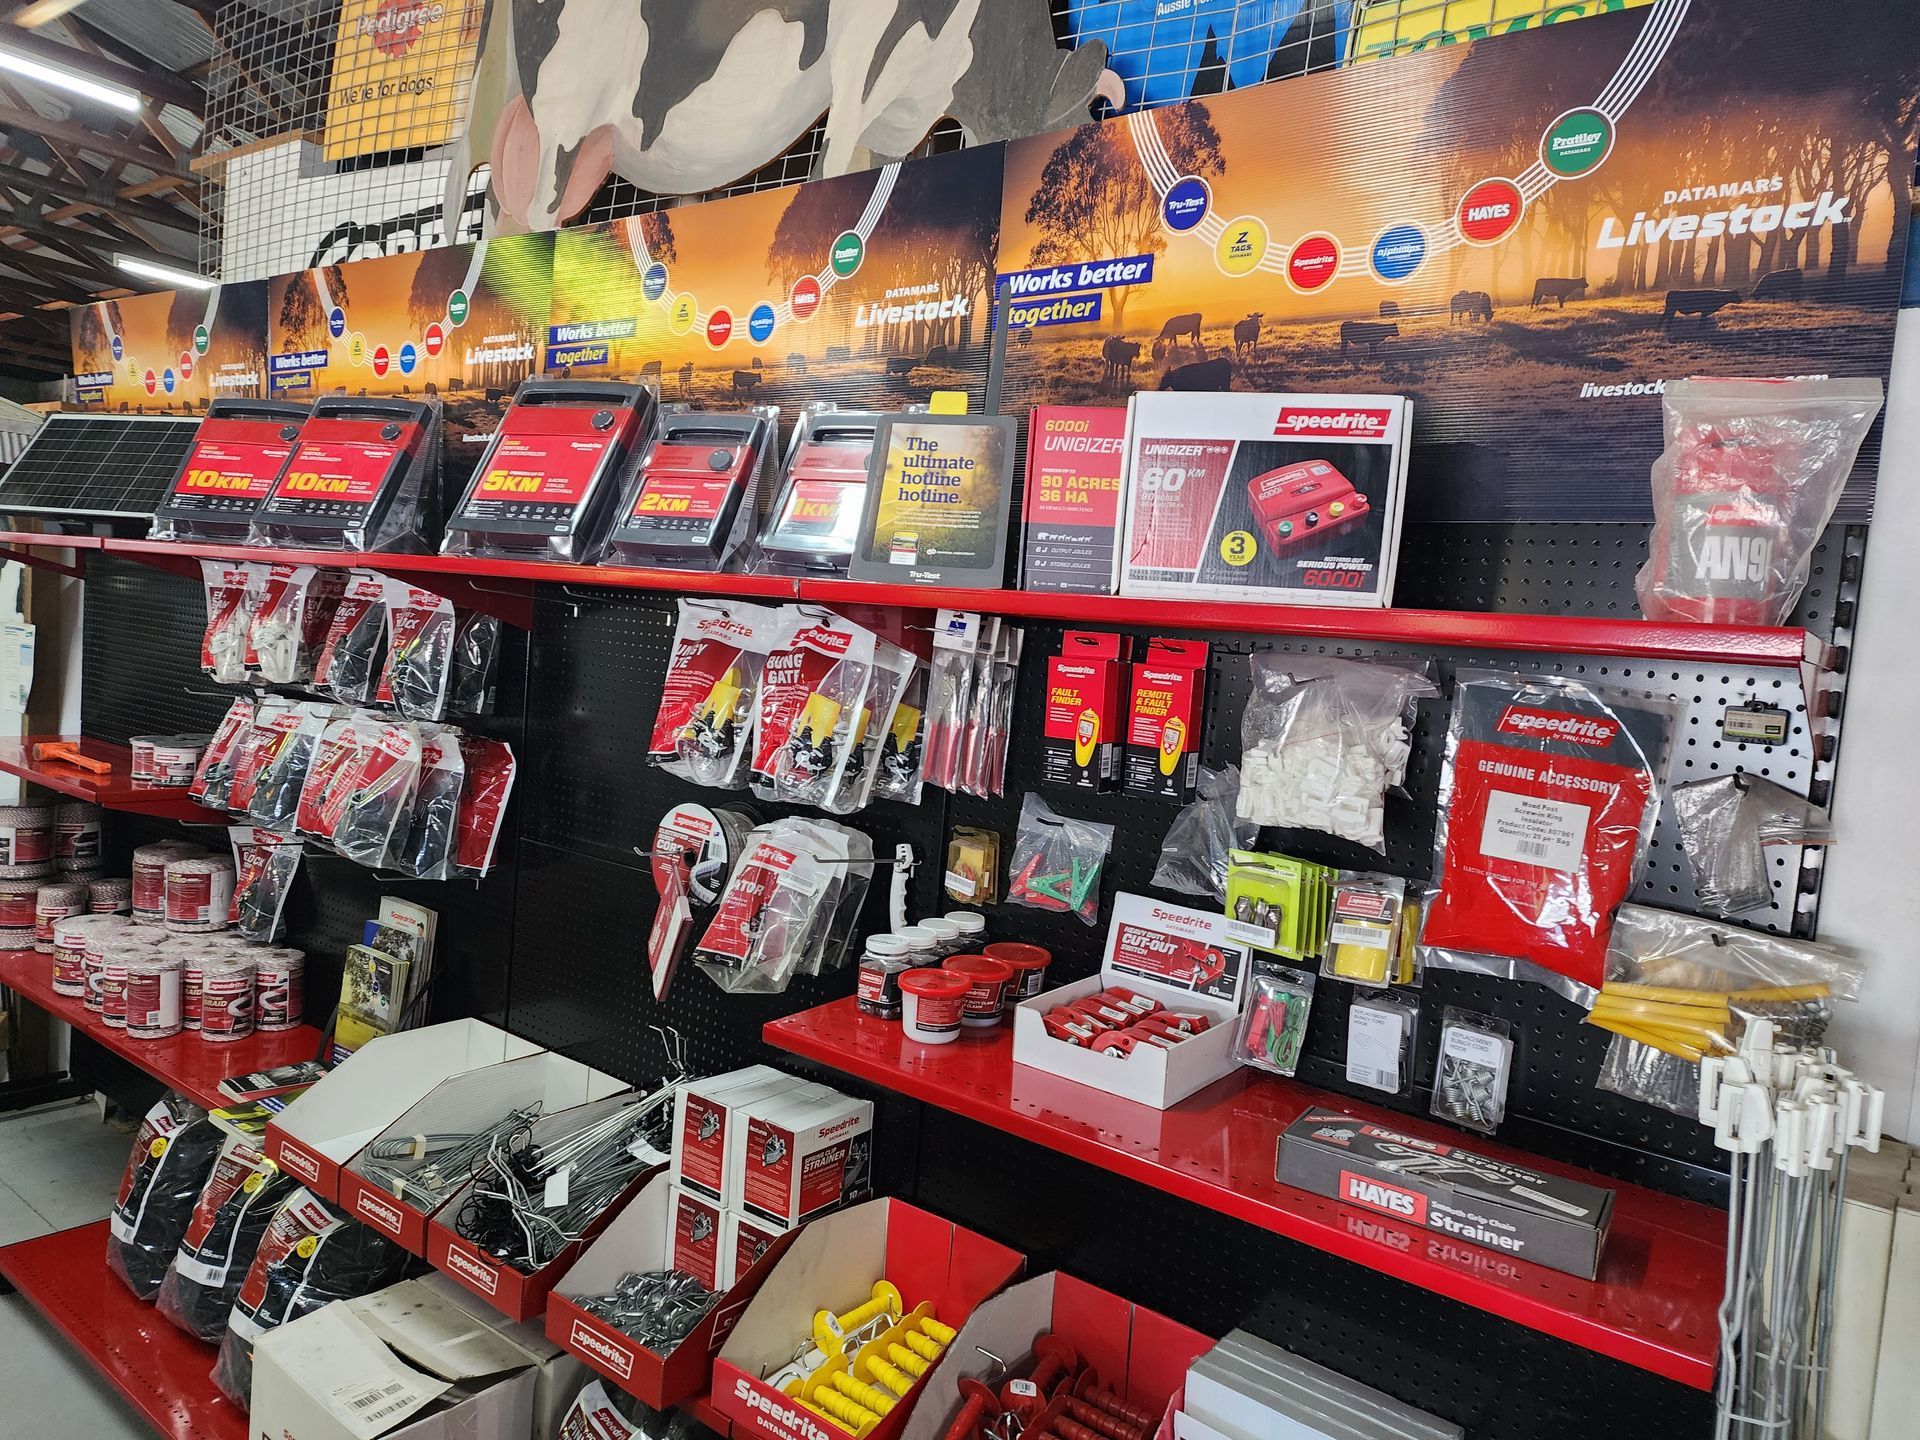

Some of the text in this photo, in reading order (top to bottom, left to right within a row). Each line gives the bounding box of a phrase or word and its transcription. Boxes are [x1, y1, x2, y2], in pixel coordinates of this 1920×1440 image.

[354, 4, 444, 39] Pedigree
[398, 76, 433, 95] dogs
[1552, 132, 1602, 150] Prattley
[1663, 177, 1784, 204] DATAMARS
[1168, 197, 1205, 210] Tru-Test
[1468, 203, 1511, 221] HAYES
[1596, 191, 1851, 249] Livestock
[1235, 231, 1249, 244] Z
[1230, 244, 1252, 252] TAGS
[1293, 255, 1335, 267] Speedrite
[1009, 261, 1146, 295] Works better
[885, 283, 940, 299] DATAMARS
[855, 295, 968, 328] Livestock
[1009, 299, 1095, 326] together
[556, 320, 634, 343] Works better
[275, 351, 327, 369] Works better
[464, 343, 534, 365] Livestock
[555, 347, 605, 367] together
[208, 371, 259, 388] Livestock
[276, 373, 309, 388] together
[1580, 379, 1666, 398] livestock
[1045, 419, 1089, 433] 6000i
[1286, 413, 1381, 431] speedrite
[906, 437, 938, 452] The
[1044, 436, 1124, 454] UNIGIZER
[1145, 444, 1203, 456] UNIGIZER
[903, 455, 975, 470] ultimate
[186, 469, 251, 490] 10KM
[285, 472, 350, 493] 10KM
[483, 470, 542, 493] 5KM
[900, 471, 961, 487] hotline
[1040, 475, 1120, 491] 90 ACRES
[1141, 467, 1206, 493] 60 KM
[639, 492, 690, 512] 2KM
[898, 488, 962, 504] hotline.
[1039, 489, 1089, 503] 36 HA
[1229, 536, 1245, 554] 3
[1296, 561, 1373, 571] SERIOUS POWER!
[1695, 535, 1772, 583] AN9
[909, 571, 941, 579] Tru-Test
[1303, 569, 1366, 588] 6000i
[1057, 664, 1095, 675] Speedrite
[1142, 670, 1183, 682] Speedrite
[1051, 687, 1079, 697] FAULT
[1051, 695, 1082, 706] FINDER
[1136, 688, 1173, 700] REMOTE
[1135, 706, 1168, 716] FINDER
[1136, 697, 1173, 709] & FAULT
[1509, 711, 1612, 739] speedrite
[1478, 760, 1620, 795] GENUINE ACCESSORY
[1514, 807, 1544, 817] Screw-in
[1521, 801, 1540, 810] Wood
[1497, 819, 1525, 830] Product
[1526, 824, 1546, 833] Code:
[1521, 816, 1552, 827] Insulator
[1498, 827, 1531, 840] Quantity:
[1532, 832, 1541, 840] 25
[1556, 837, 1571, 847] Bag
[1152, 907, 1212, 930] Speedrite
[1123, 926, 1166, 941] HEAVY DUTY
[1120, 944, 1149, 956] SWITCH
[1121, 933, 1178, 955] CUT-OUT
[1208, 985, 1219, 995] 10
[1354, 1009, 1387, 1020] REPLACEMENT
[1354, 1014, 1385, 1025] BUNGY CORD
[1450, 1037, 1489, 1052] BUNGY CORD
[1451, 1031, 1493, 1046] REPLACEMENT
[1450, 1045, 1467, 1053] HOOK
[818, 1116, 860, 1138] Speedrite
[1370, 1128, 1438, 1151] HAYES
[283, 1150, 316, 1172] speedrite
[803, 1149, 846, 1173] STRAINER
[1451, 1152, 1548, 1185] Strainer
[1349, 1178, 1416, 1215] HAYES
[362, 1197, 399, 1224] speedrite
[1431, 1200, 1516, 1233] Smooth Grip Chain
[1430, 1212, 1525, 1252] Strainer
[452, 1252, 495, 1284] speedrite
[577, 1329, 627, 1366] speedrite
[734, 1378, 830, 1440] Speedrite
